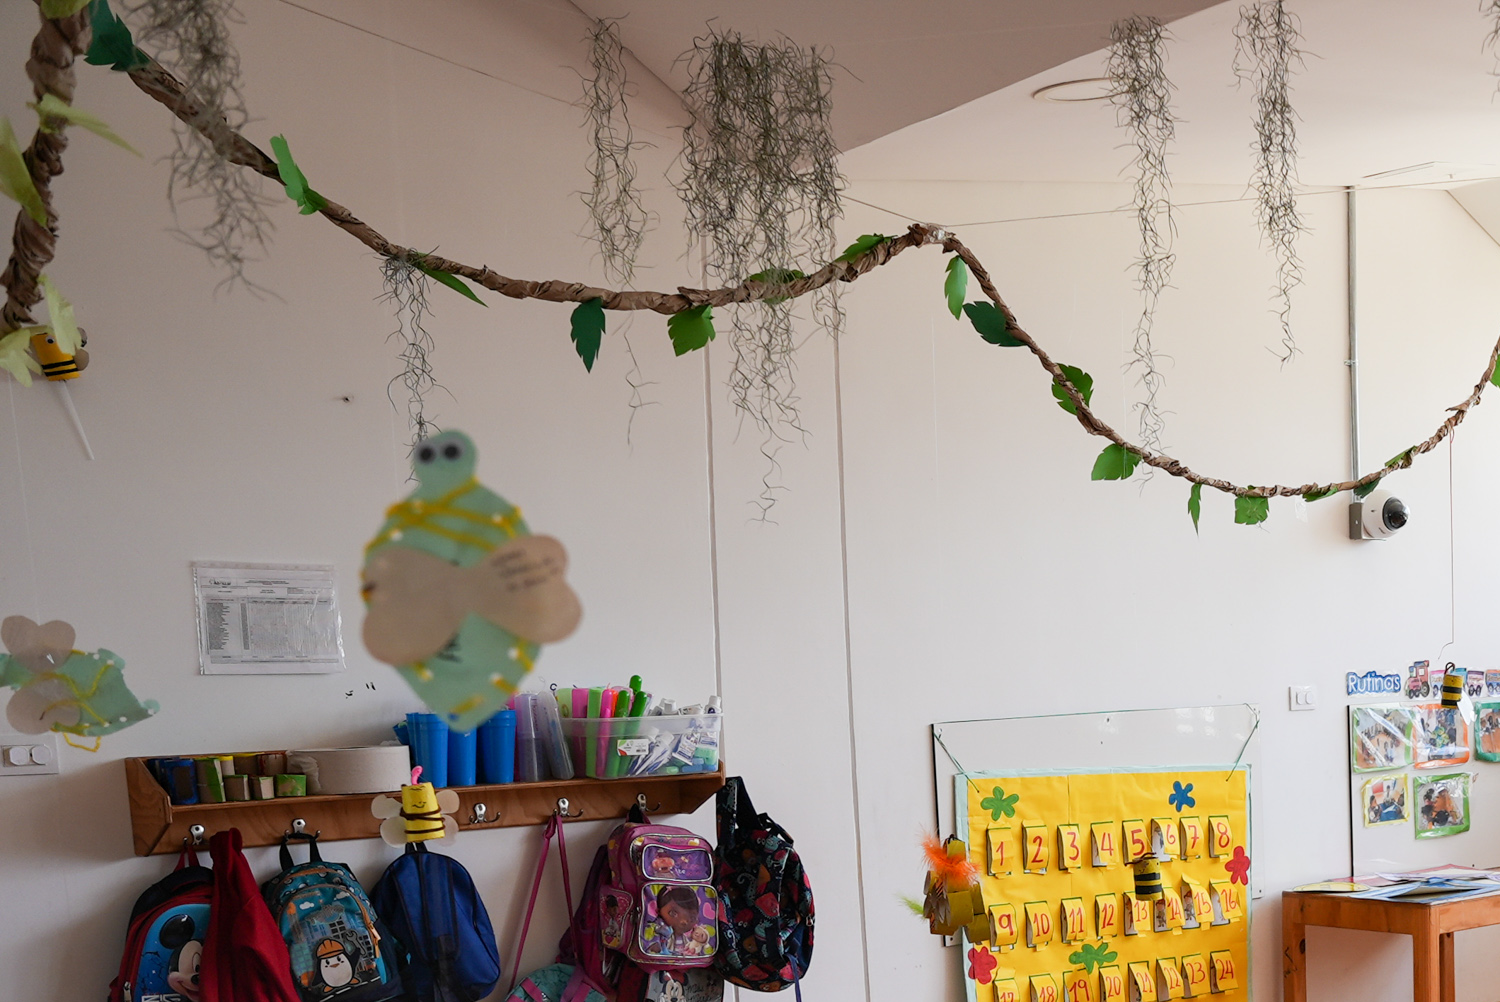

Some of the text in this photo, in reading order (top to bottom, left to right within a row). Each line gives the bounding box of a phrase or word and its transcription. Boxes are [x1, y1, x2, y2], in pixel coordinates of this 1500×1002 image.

[1348, 672, 1401, 694] Rutinas
[996, 822, 1230, 866] 1 2 3 4 5 6 7 8
[999, 889, 1236, 937] 9 10 11 12 13 14 15 16
[1106, 976, 1121, 998] 20
[1136, 972, 1153, 994] 21
[1164, 967, 1181, 990] 22
[1186, 961, 1206, 984] 23
[1216, 959, 1234, 981] 24
